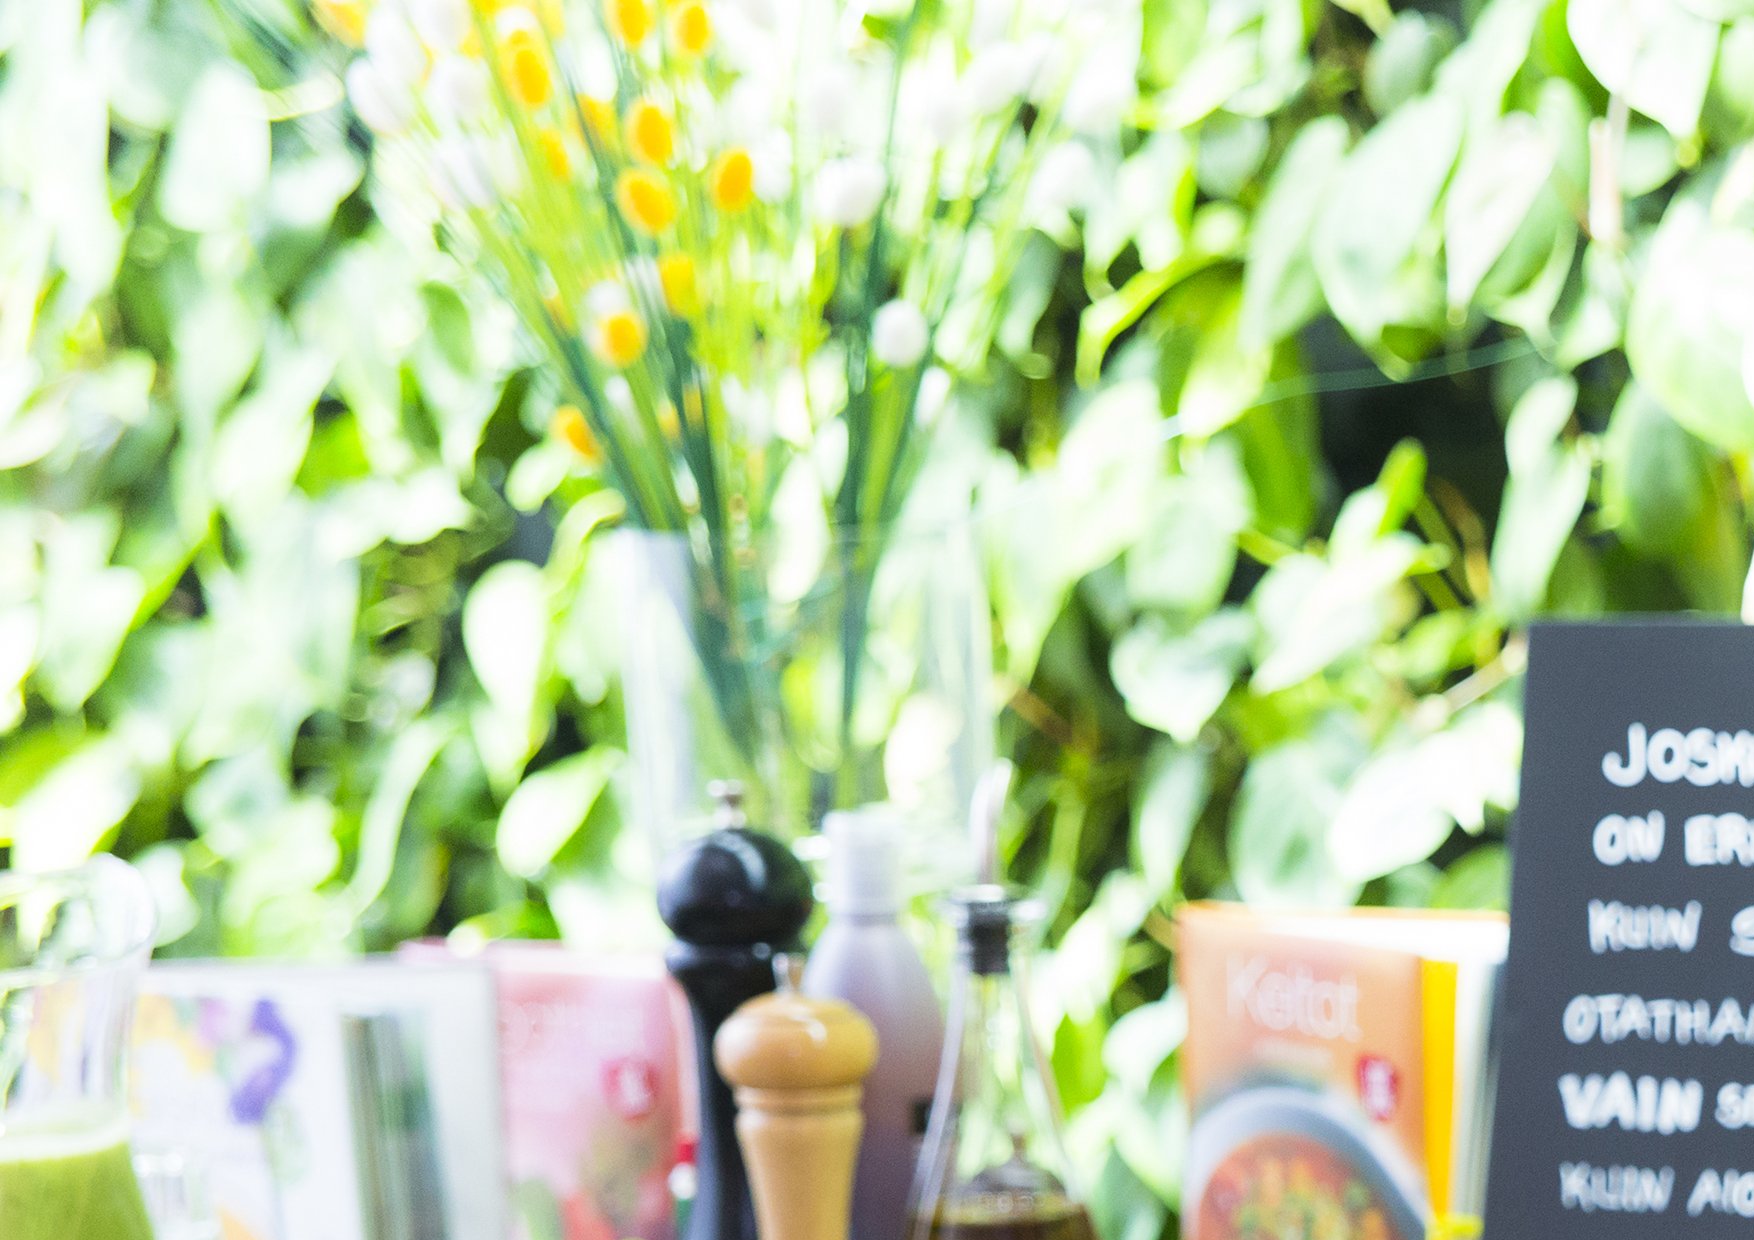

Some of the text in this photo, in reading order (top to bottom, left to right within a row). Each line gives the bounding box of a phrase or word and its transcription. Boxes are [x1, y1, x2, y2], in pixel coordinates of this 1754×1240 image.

[1592, 810, 1666, 866] ON
[1588, 899, 1702, 954] KUIN
[1558, 1071, 1703, 1135] VAIN
[1559, 1162, 1674, 1212] KUIN
